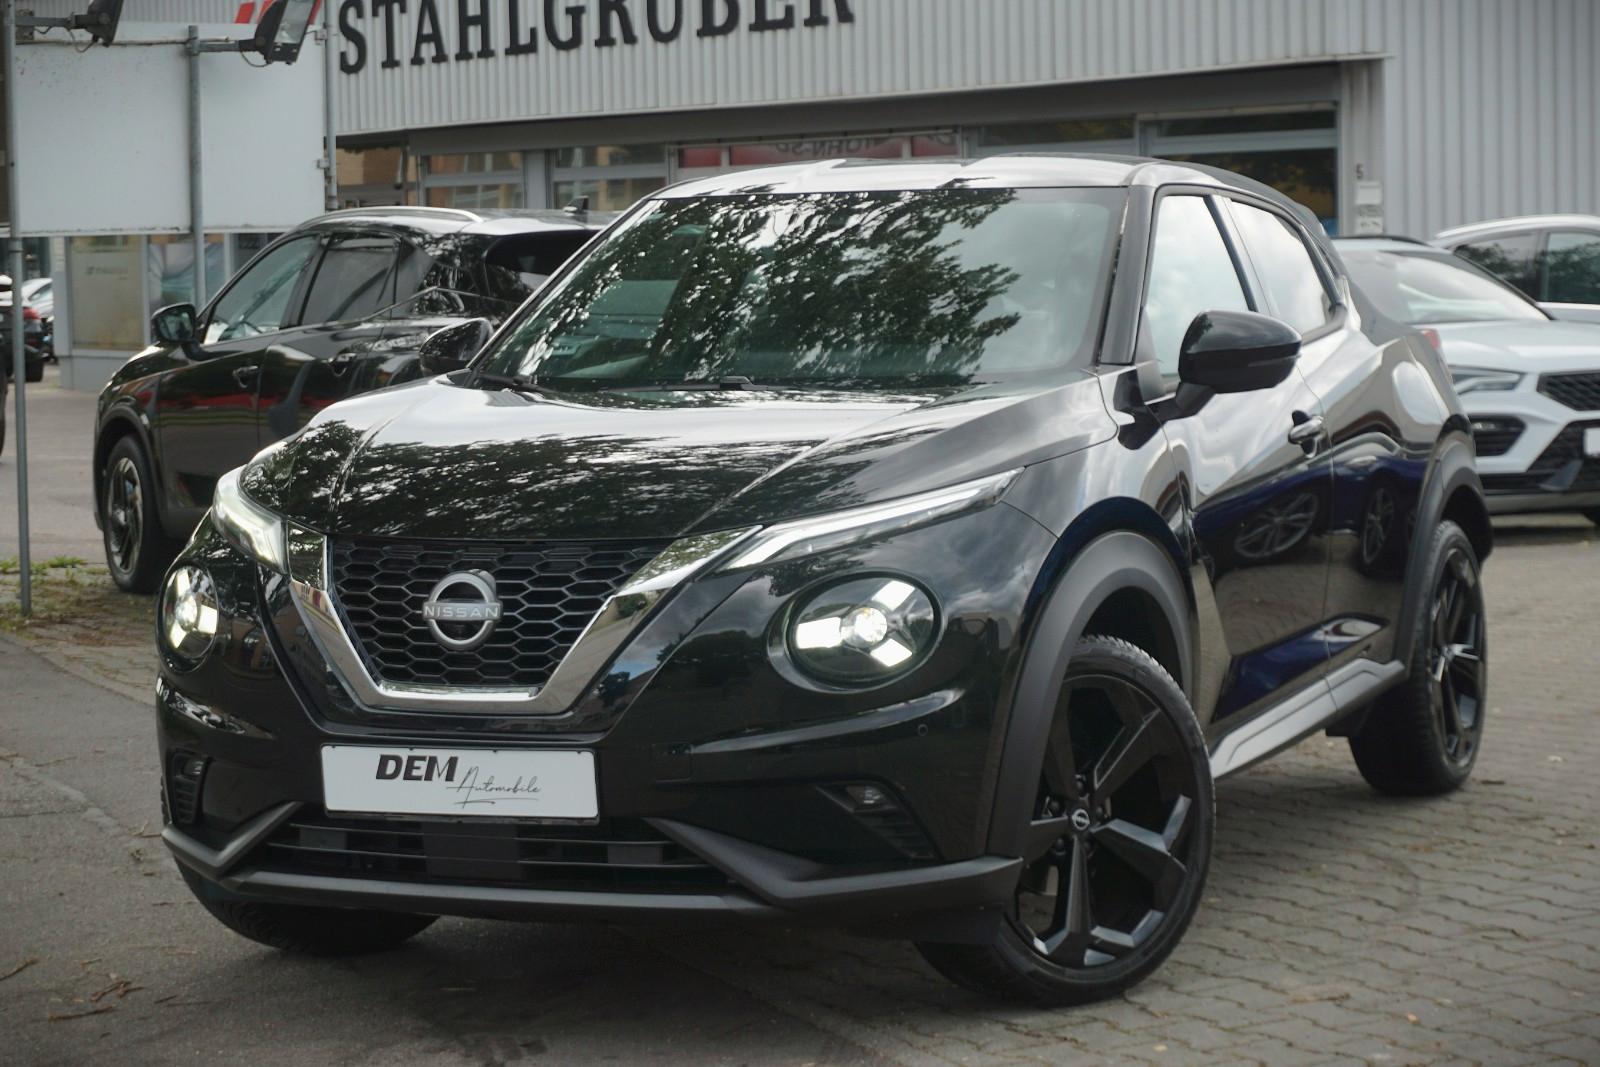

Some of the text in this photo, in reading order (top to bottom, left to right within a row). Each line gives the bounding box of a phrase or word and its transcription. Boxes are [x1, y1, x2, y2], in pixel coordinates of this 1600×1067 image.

[424, 605, 499, 618] NISSAN
[376, 754, 459, 782] DEM
[447, 766, 542, 807] Automobile
